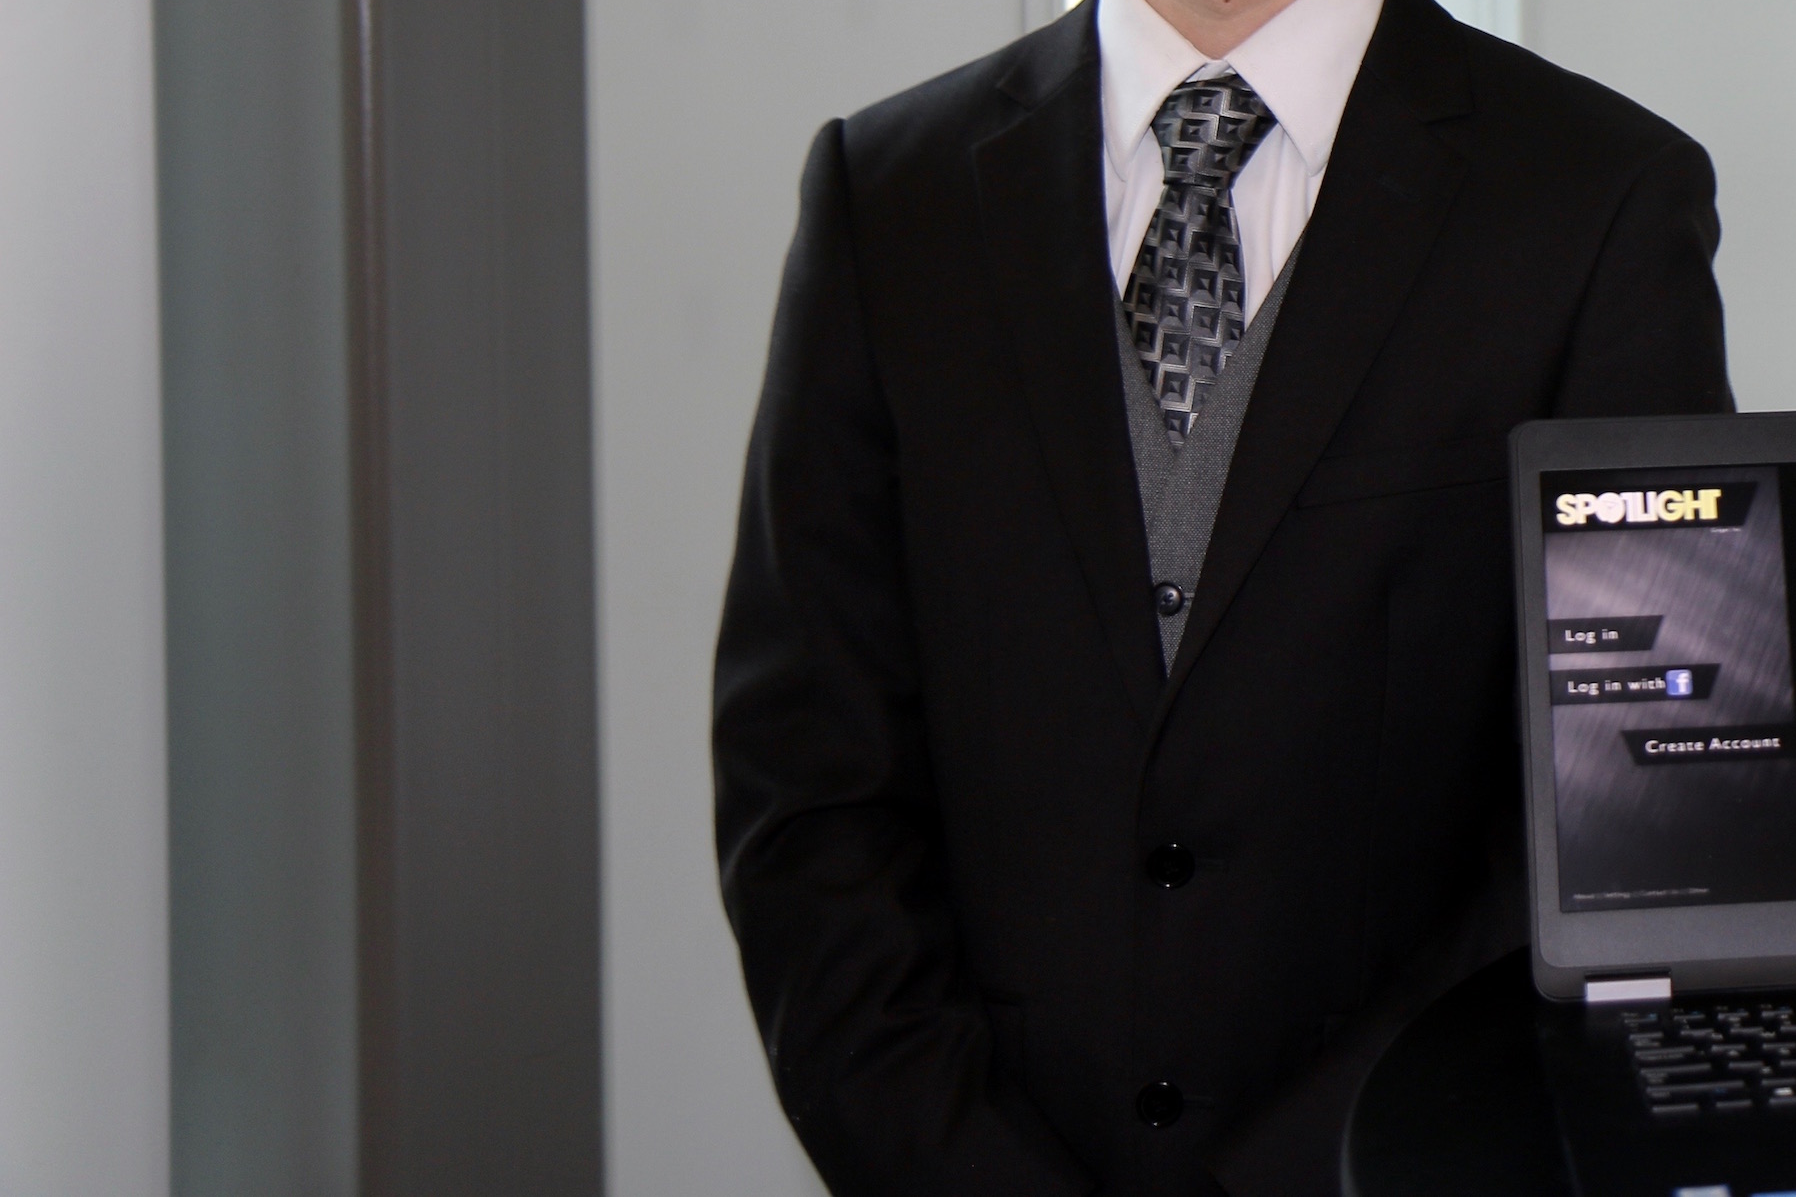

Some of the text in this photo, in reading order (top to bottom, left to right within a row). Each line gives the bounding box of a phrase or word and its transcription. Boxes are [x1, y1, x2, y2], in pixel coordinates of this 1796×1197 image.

[1555, 488, 1722, 526] SPOTLIGHT
[1564, 628, 1619, 645] Log in
[1567, 680, 1599, 696] Log
[1604, 679, 1622, 692] in
[1627, 677, 1666, 691] with
[1644, 737, 1781, 754] Create Account
